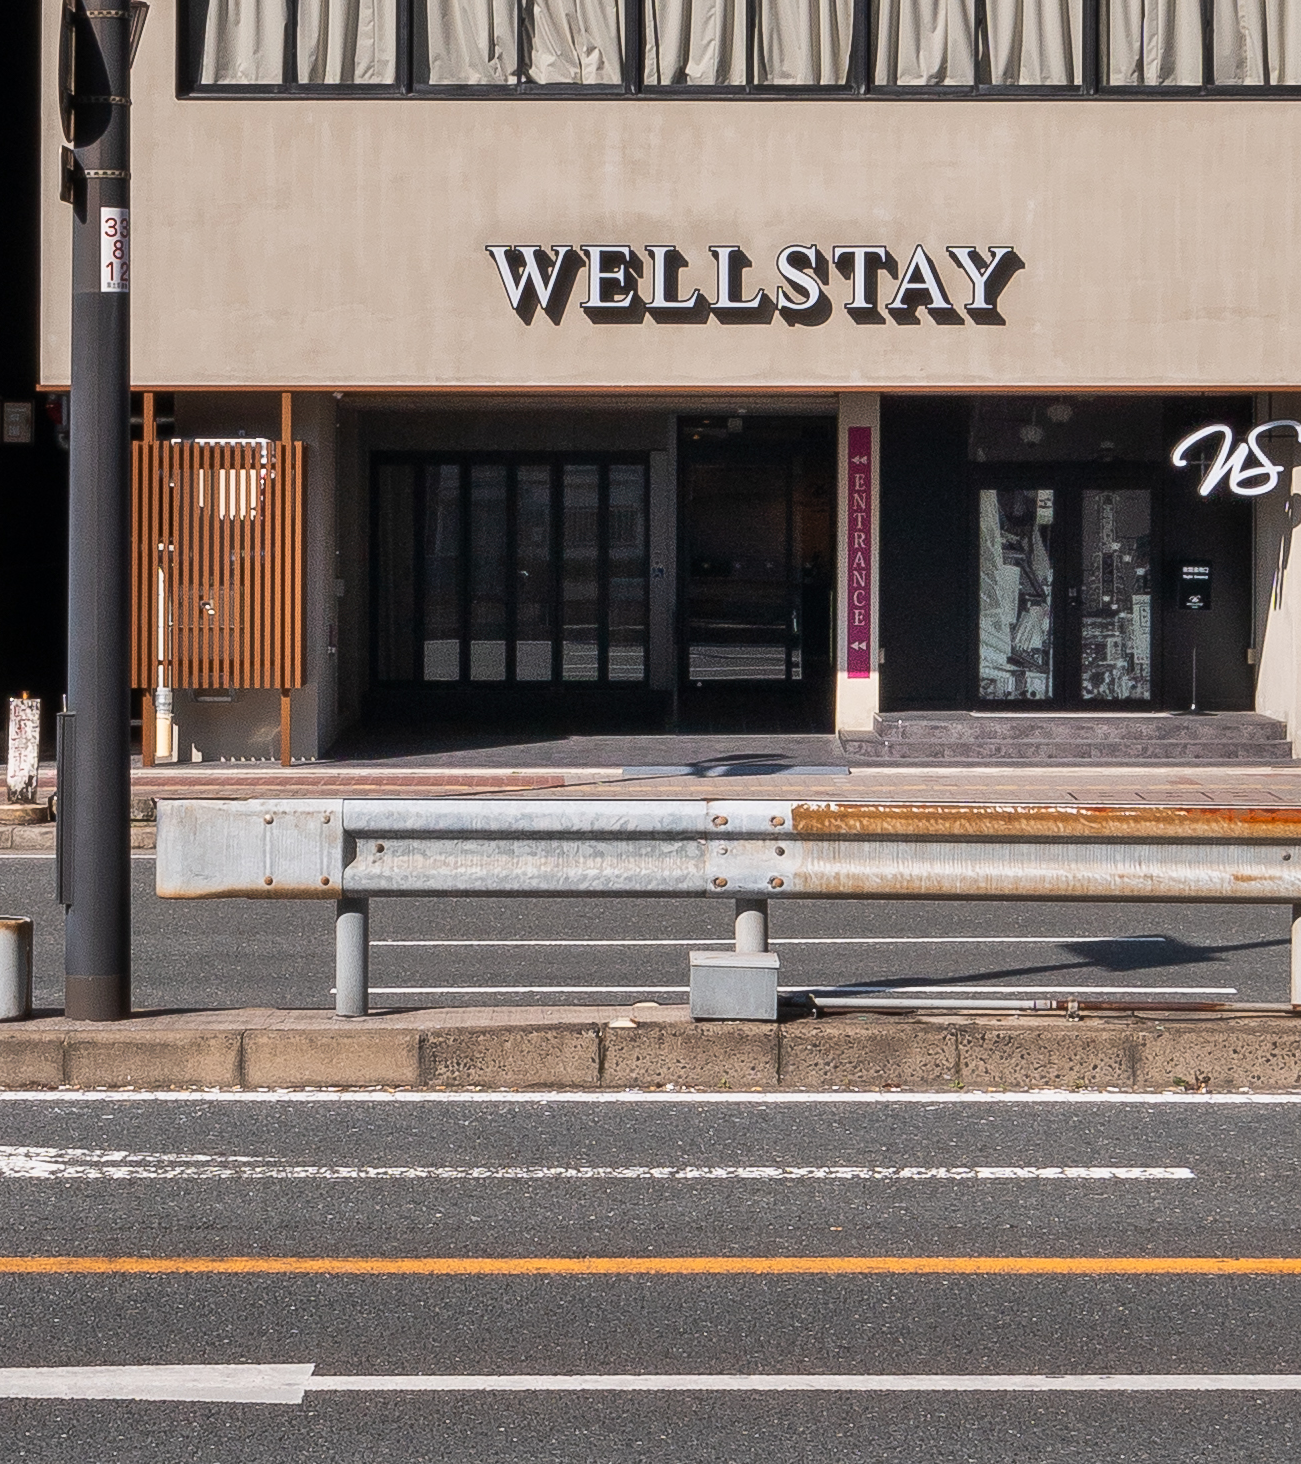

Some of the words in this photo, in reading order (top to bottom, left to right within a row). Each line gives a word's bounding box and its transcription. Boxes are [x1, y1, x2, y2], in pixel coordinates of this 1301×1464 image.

[104, 217, 129, 239] 33
[112, 239, 125, 261] 8
[105, 261, 129, 282] 12
[485, 243, 1019, 316] WELLSTAY
[852, 473, 866, 626] ENTRANCE
